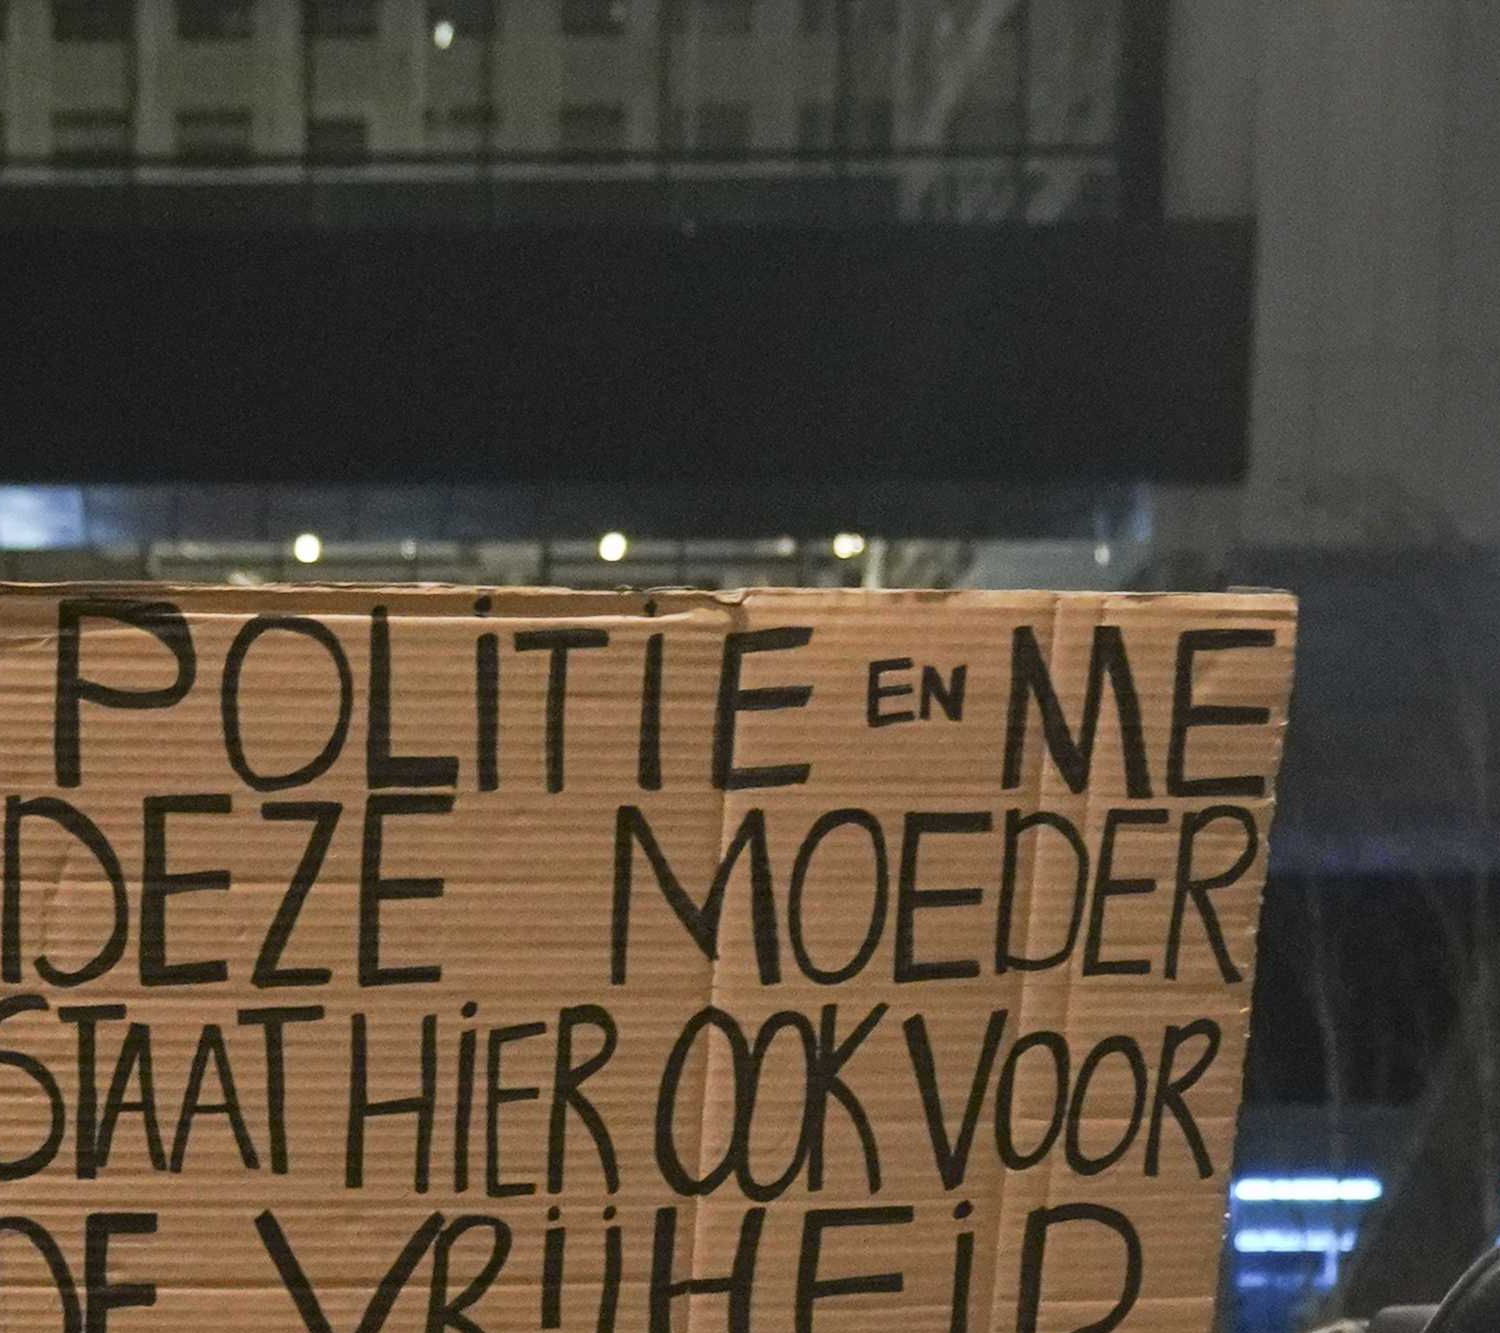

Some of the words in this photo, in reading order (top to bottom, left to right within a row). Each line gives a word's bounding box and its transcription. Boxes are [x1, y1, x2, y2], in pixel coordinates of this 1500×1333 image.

[866, 657, 967, 728] EN
[1001, 625, 1276, 798] ME
[2, 794, 457, 990] DEZE
[610, 804, 1258, 986] MOEDER
[654, 1002, 882, 1202] OOK
[903, 1009, 1222, 1190] VOOR
